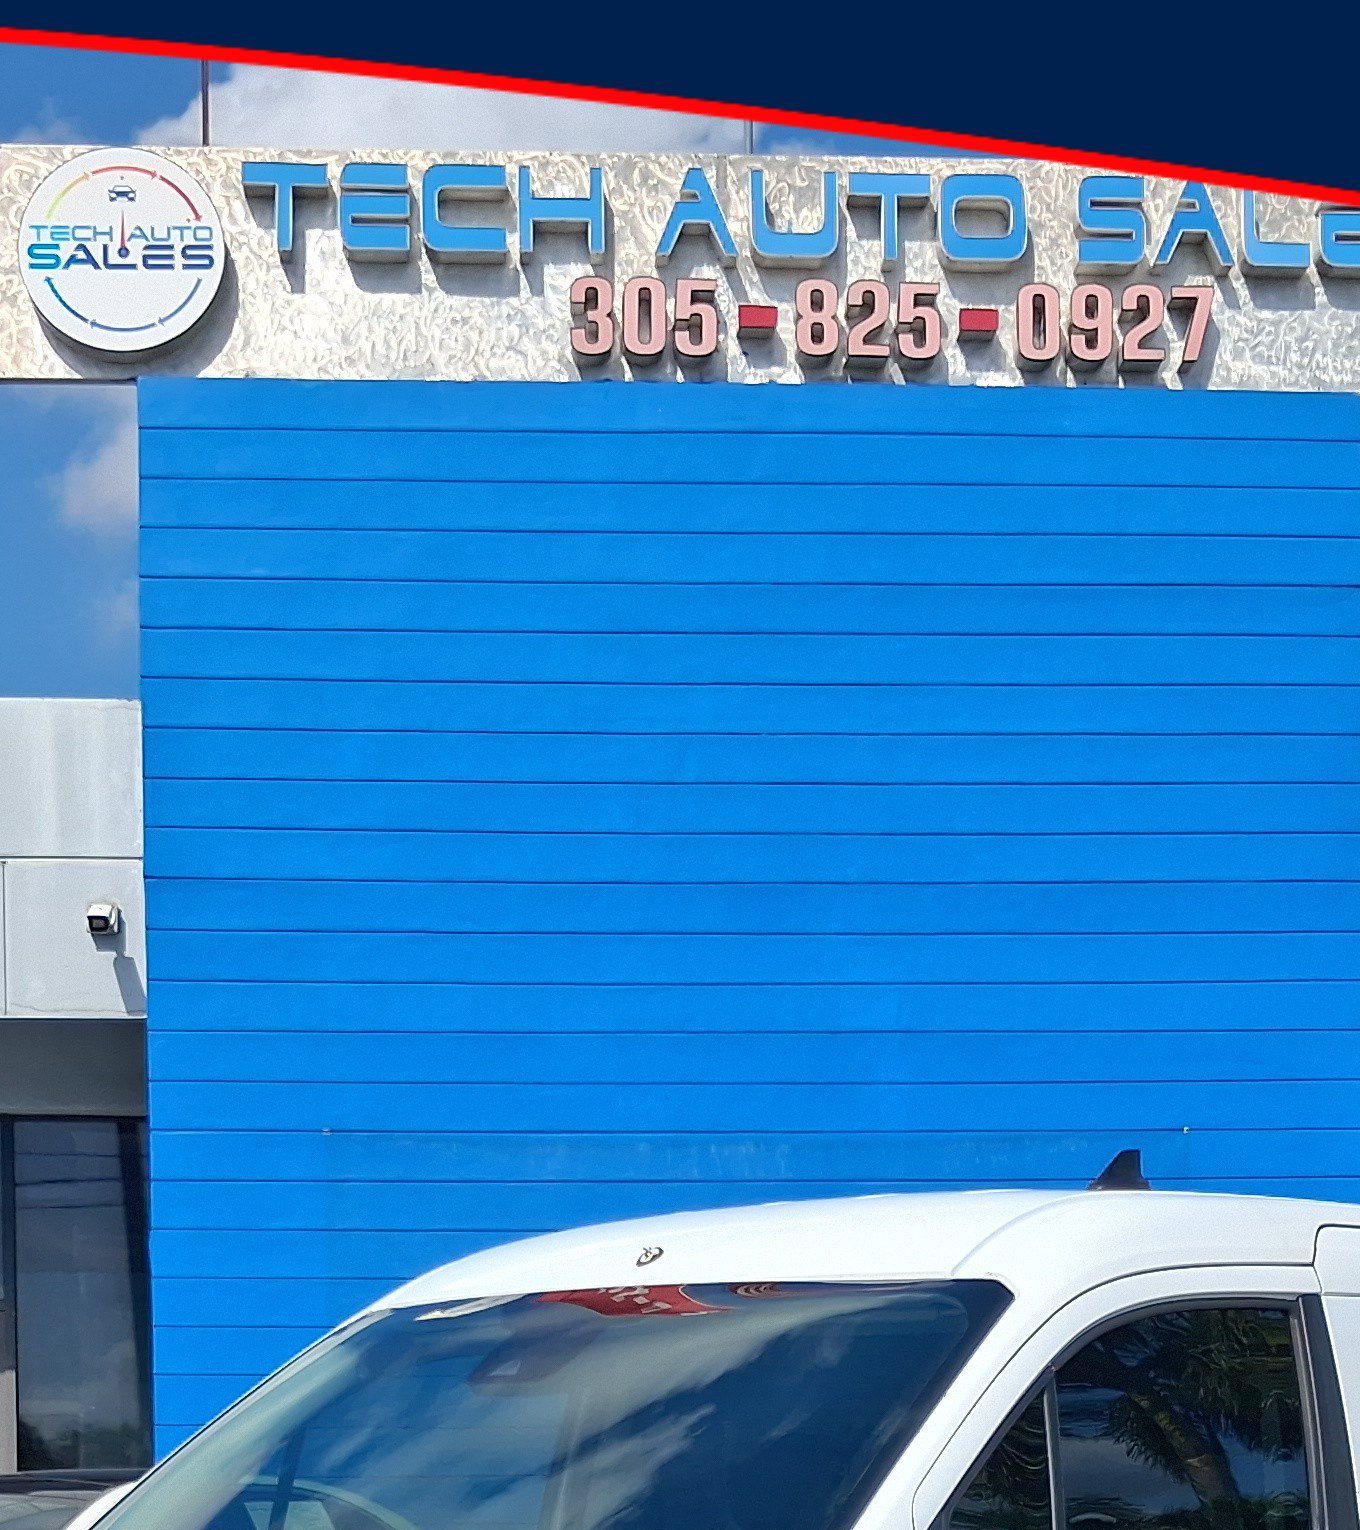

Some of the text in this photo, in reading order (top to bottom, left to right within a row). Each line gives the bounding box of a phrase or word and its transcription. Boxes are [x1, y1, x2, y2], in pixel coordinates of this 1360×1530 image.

[242, 162, 603, 260] TECH
[657, 166, 1030, 268] AUTO
[28, 224, 214, 242] TECH AUTO
[27, 243, 215, 271] SALES
